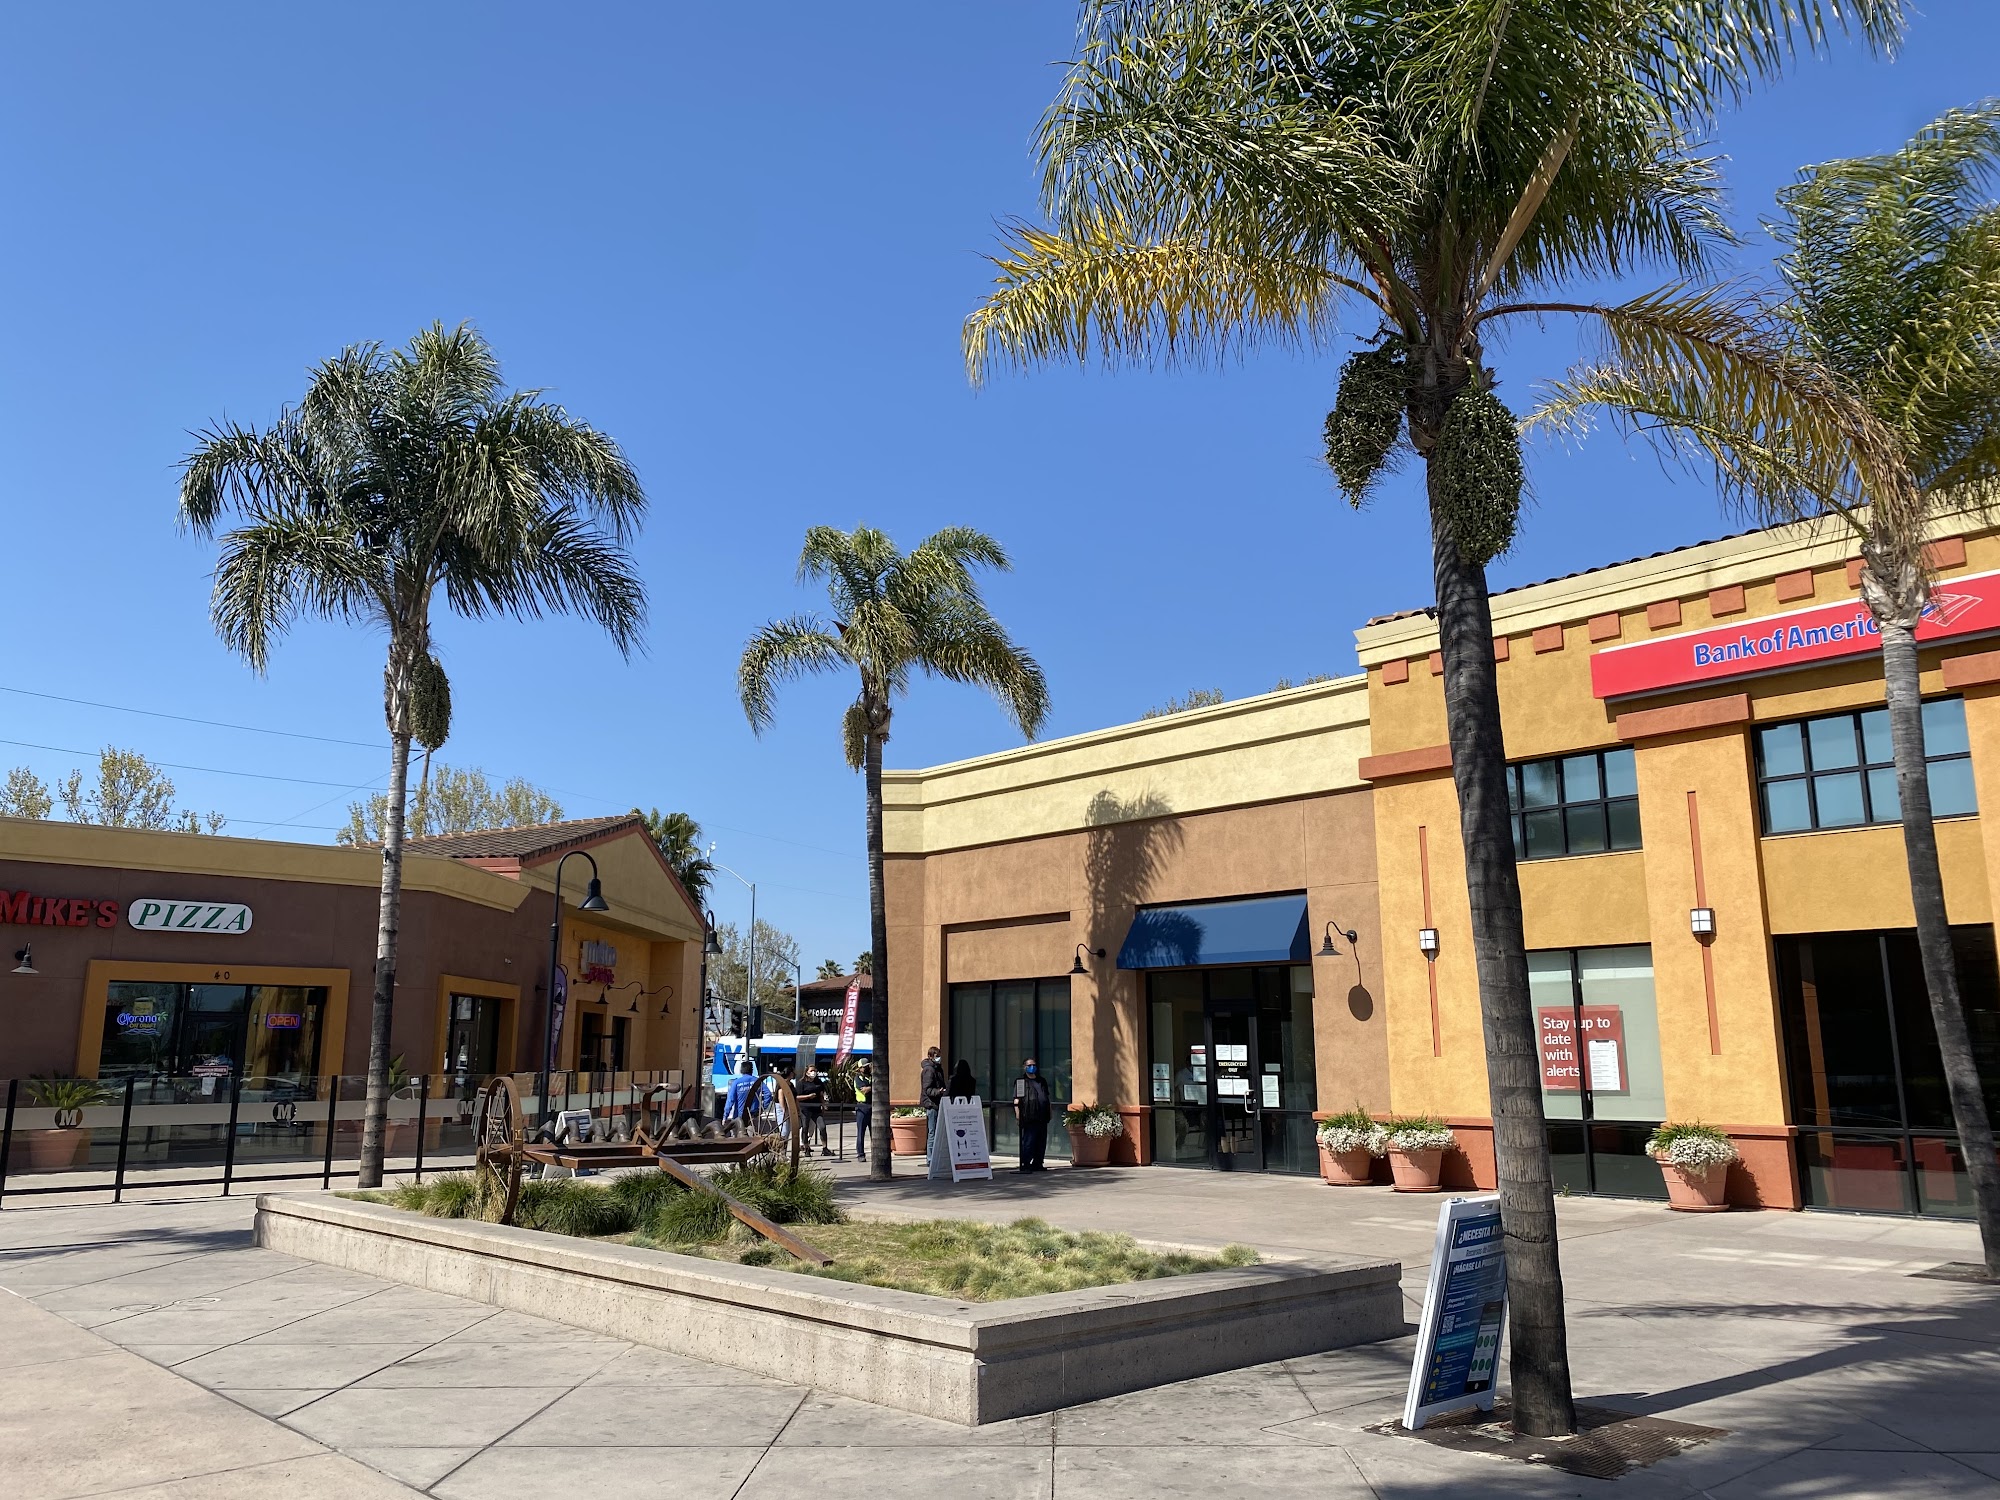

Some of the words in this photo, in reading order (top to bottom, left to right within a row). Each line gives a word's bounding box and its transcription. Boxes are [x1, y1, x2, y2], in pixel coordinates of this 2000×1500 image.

[1694, 635, 1756, 666] Bank
[1758, 628, 1783, 655] of
[1787, 612, 1883, 649] Americ
[134, 902, 248, 931] PIZZA
[845, 991, 858, 1024] OPEN
[116, 1012, 157, 1026] Corona
[268, 1015, 298, 1027] OPEN
[1543, 1017, 1570, 1032] Stay
[1574, 1018, 1594, 1032] up
[1596, 1017, 1611, 1028] to
[841, 1026, 854, 1054] NOW
[1544, 1033, 1571, 1045] date
[1545, 1048, 1573, 1061] with
[1546, 1064, 1580, 1077] alerts
[59, 1109, 78, 1126] M
[277, 1104, 292, 1120] M
[1458, 1226, 1491, 1244] ¿NECESITA
[1475, 1260, 1482, 1270] LA
